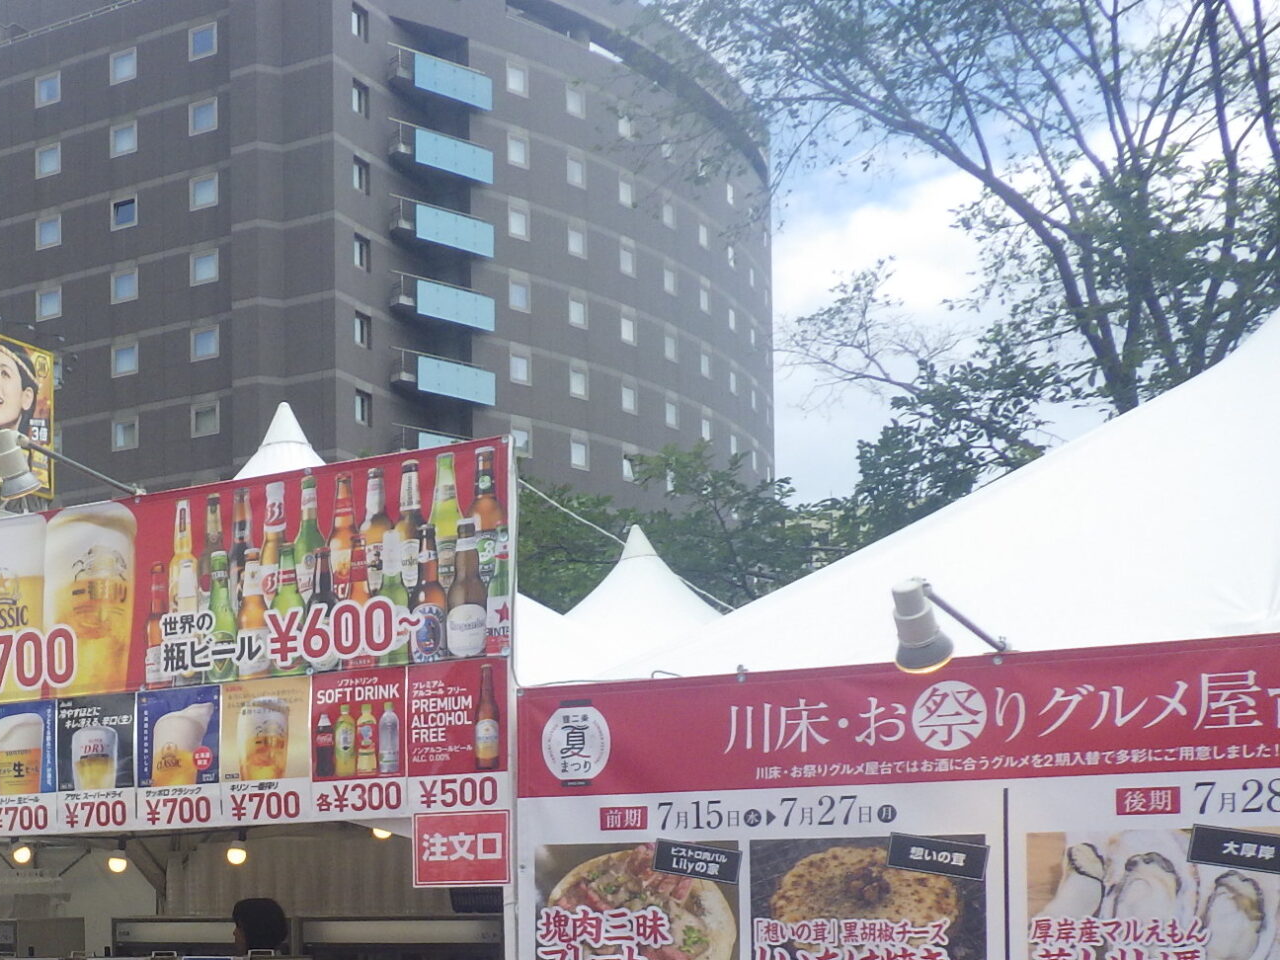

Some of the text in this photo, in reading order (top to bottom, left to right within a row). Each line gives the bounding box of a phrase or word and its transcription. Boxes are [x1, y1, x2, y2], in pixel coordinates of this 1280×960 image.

[162, 614, 212, 636] 世界の
[163, 635, 261, 672] 瓶ビール
[337, 677, 378, 686] ソフトドリンク
[412, 681, 444, 689] プレミアム
[317, 688, 352, 705] SOFT
[356, 683, 399, 701] DRINK
[412, 696, 472, 713] PREMIUM
[412, 711, 472, 728] ALCOHOL
[412, 728, 446, 743] FREE
[561, 725, 591, 759] 夏
[412, 744, 472, 754] ノンアルコールビール
[561, 760, 591, 773] まつり
[420, 776, 497, 808] ¥500
[1123, 789, 1172, 813] 後期
[65, 800, 127, 828] ¥700
[146, 796, 211, 825] ¥700
[231, 791, 300, 820] ¥700
[605, 808, 642, 828] 前期
[423, 832, 502, 861] 注文口
[540, 910, 669, 944] 塊肉三昧
[1031, 919, 1207, 944] 厚岸産マルえもん
